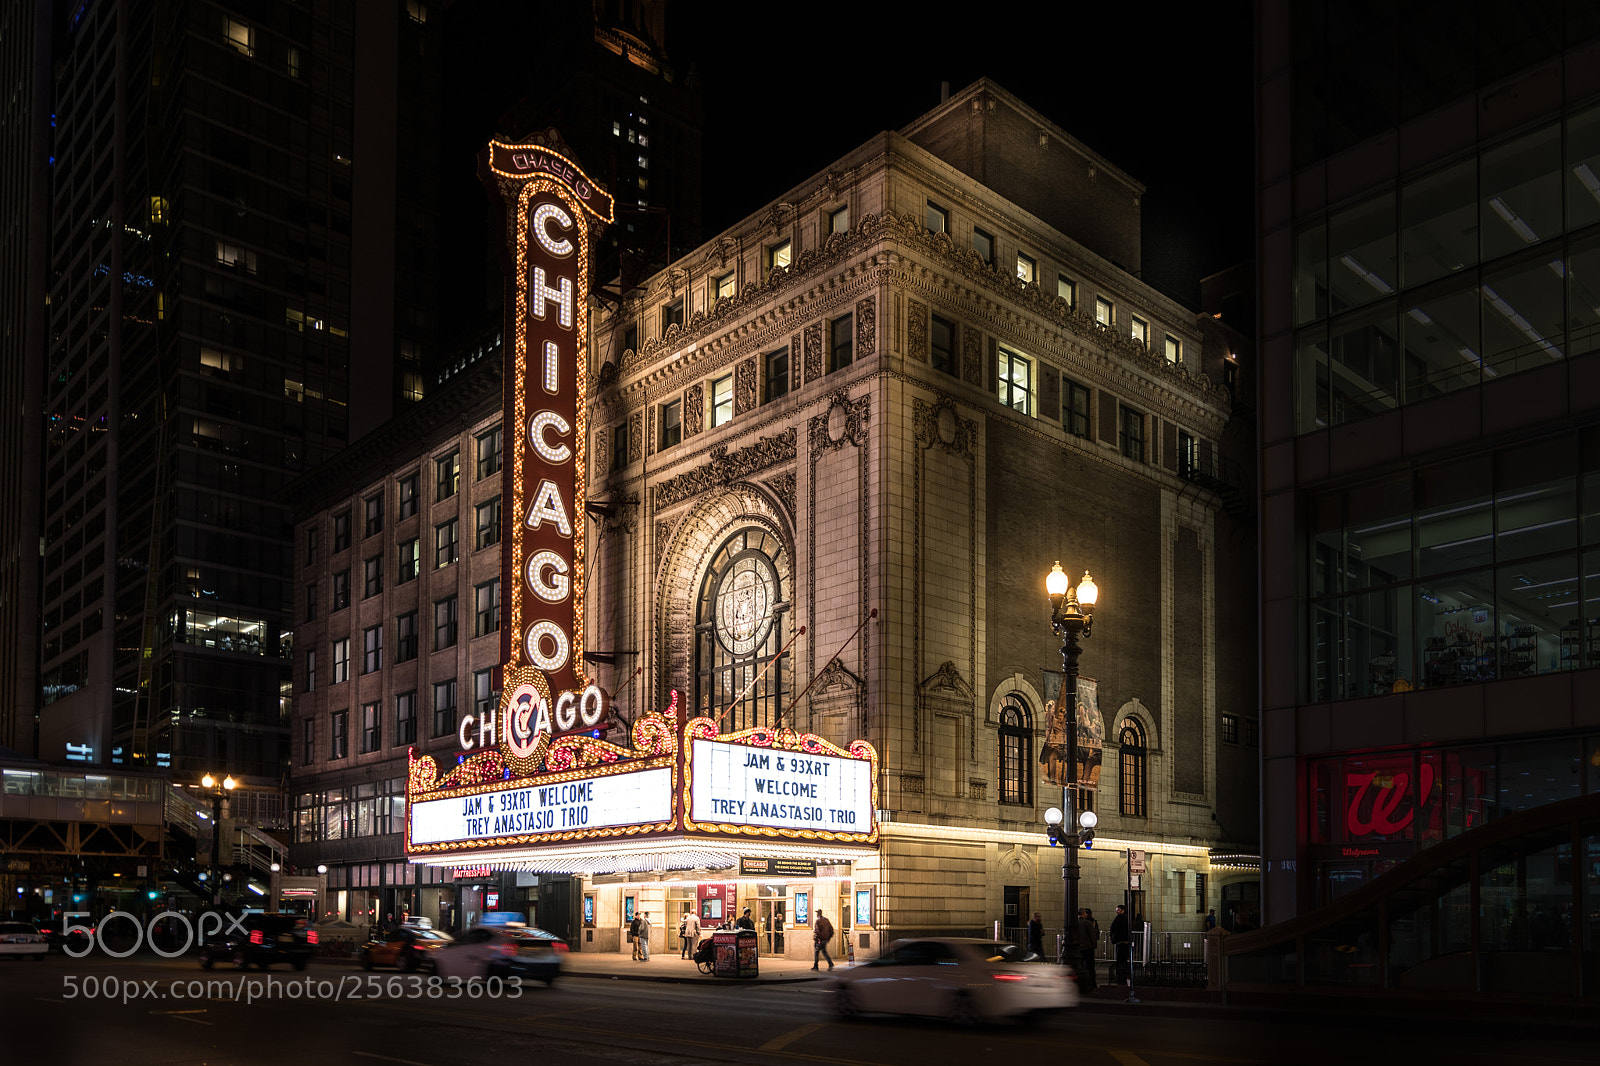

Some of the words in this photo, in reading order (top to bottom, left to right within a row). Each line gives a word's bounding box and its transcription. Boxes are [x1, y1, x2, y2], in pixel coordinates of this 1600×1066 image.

[512, 153, 574, 185] CHASE
[527, 203, 574, 671] CHICAGO
[459, 685, 602, 750] CHICAGO
[743, 753, 770, 770] JAM
[776, 757, 785, 771] &
[790, 758, 830, 777] 93XRT
[462, 797, 482, 816] JAM
[488, 795, 494, 813] &
[501, 790, 531, 812] 93XRT
[539, 781, 593, 807] WELCOME
[755, 778, 817, 799] WELCOME
[466, 816, 490, 836] TREY
[494, 809, 554, 834] ANASTASIO
[561, 805, 588, 827] TRIO
[711, 798, 745, 816] TREY
[750, 801, 823, 821] ANASTASIO
[829, 808, 856, 824] TRIO
